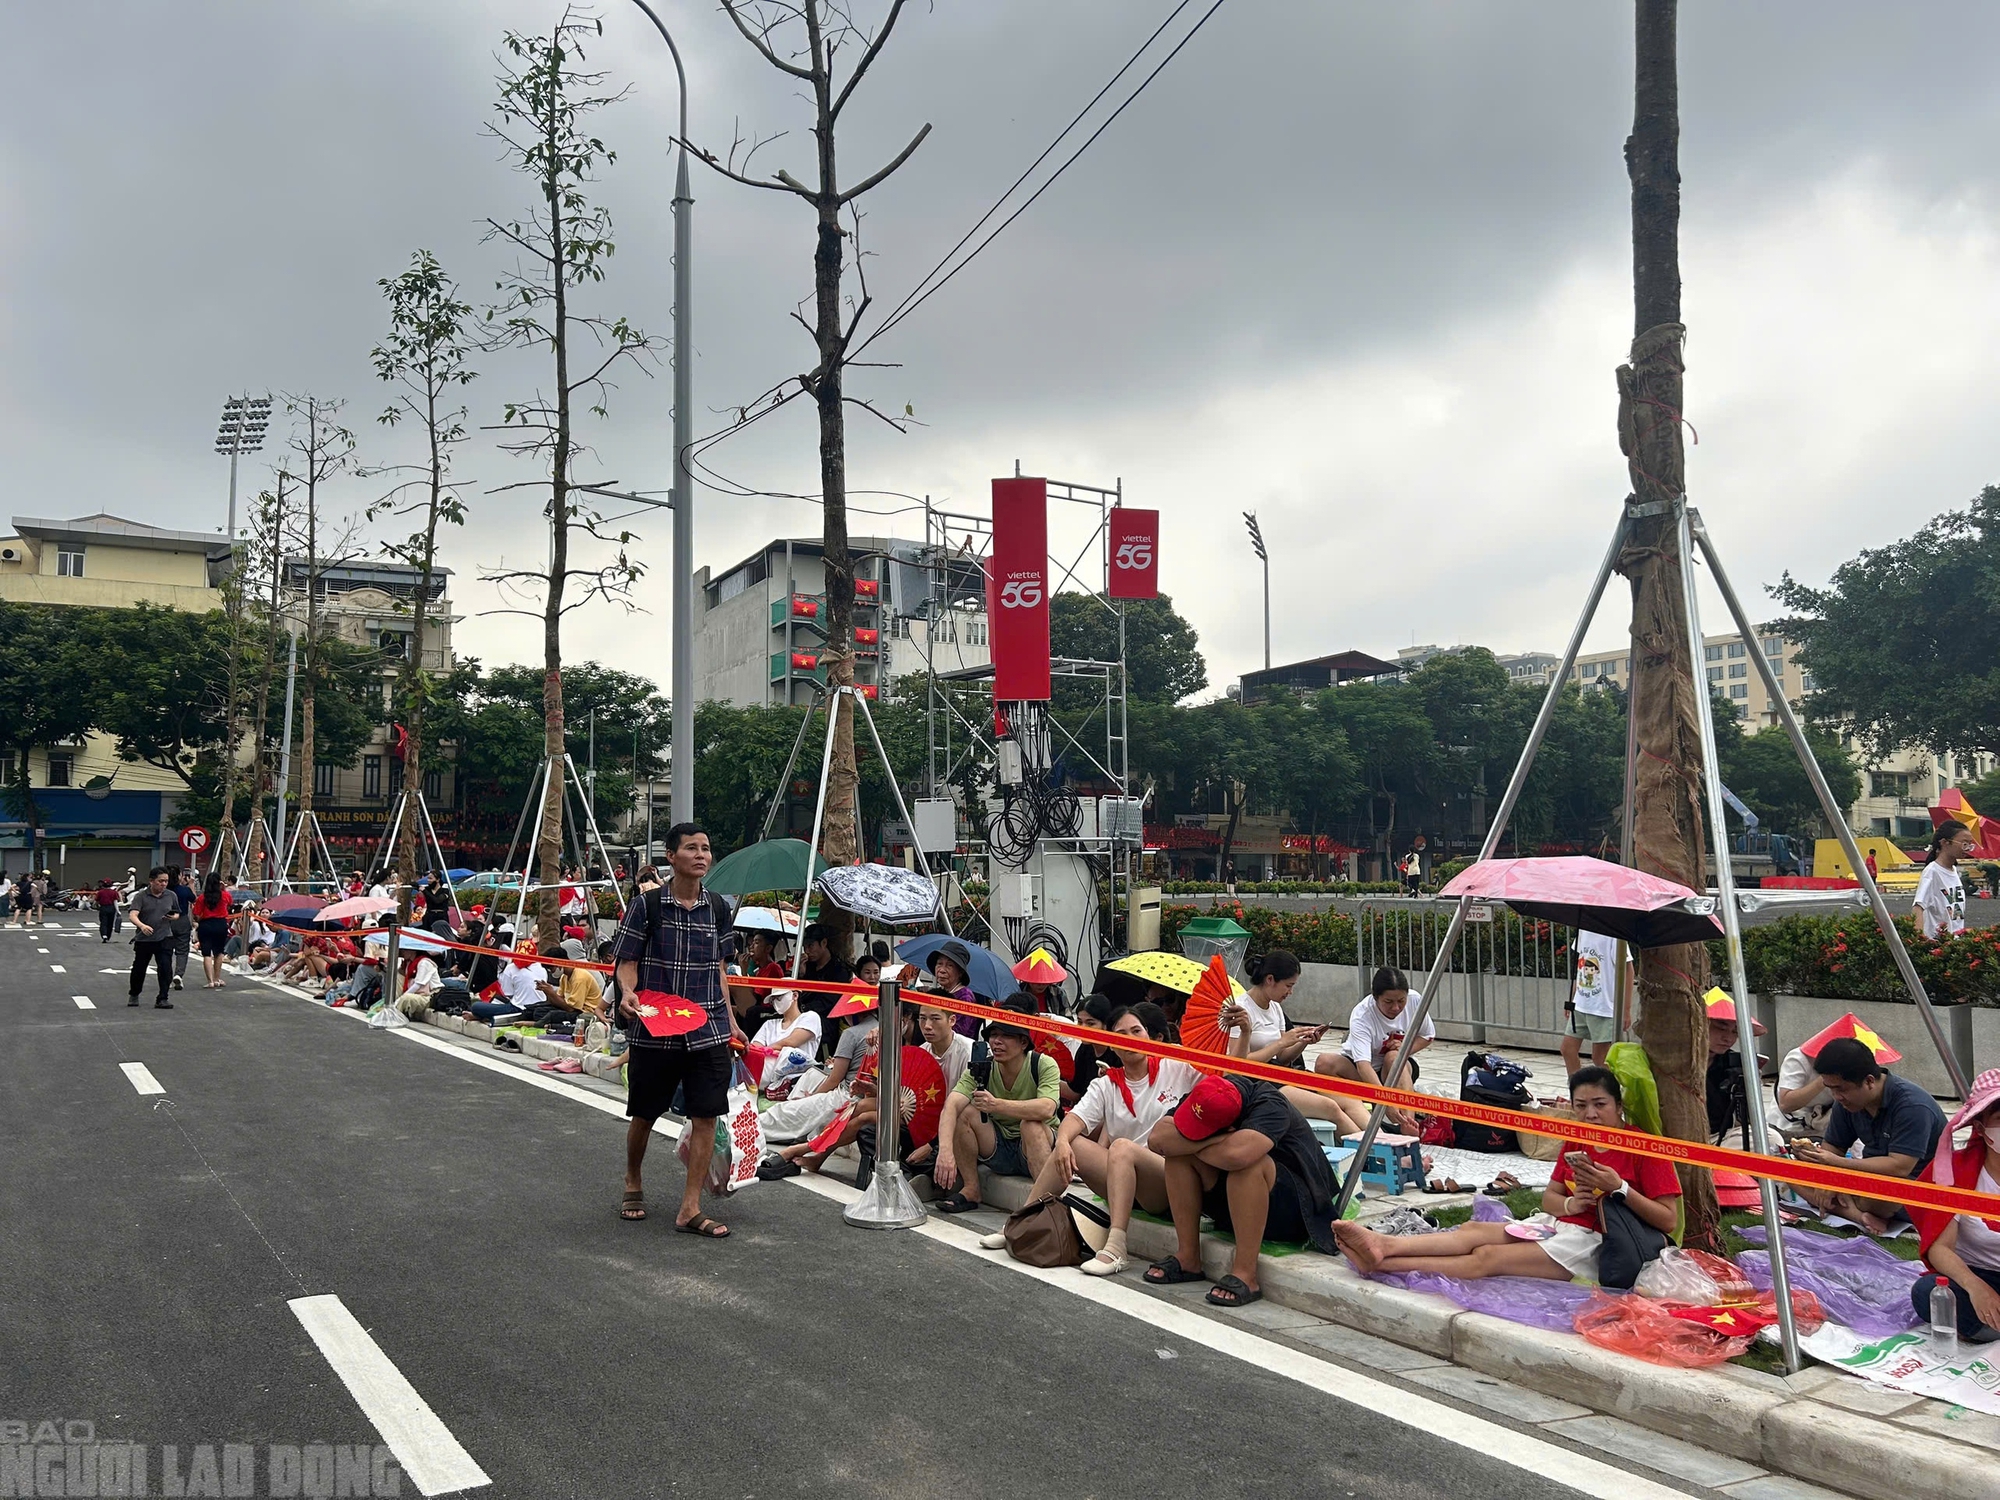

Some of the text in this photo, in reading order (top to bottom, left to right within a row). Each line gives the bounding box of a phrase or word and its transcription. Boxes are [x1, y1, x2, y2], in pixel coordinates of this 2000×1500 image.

[1122, 535, 1152, 543] viettel
[1115, 544, 1152, 570] 5G
[1007, 571, 1041, 580] viettel
[1000, 581, 1042, 608] 5G
[1513, 1115, 1534, 1128] QUA
[1541, 1120, 1577, 1137] POLICE
[1579, 1128, 1605, 1142] LINE.
[1607, 1135, 1623, 1146] DO
[1625, 1138, 1648, 1150] NOT
[1650, 1141, 1689, 1157] CROSS
